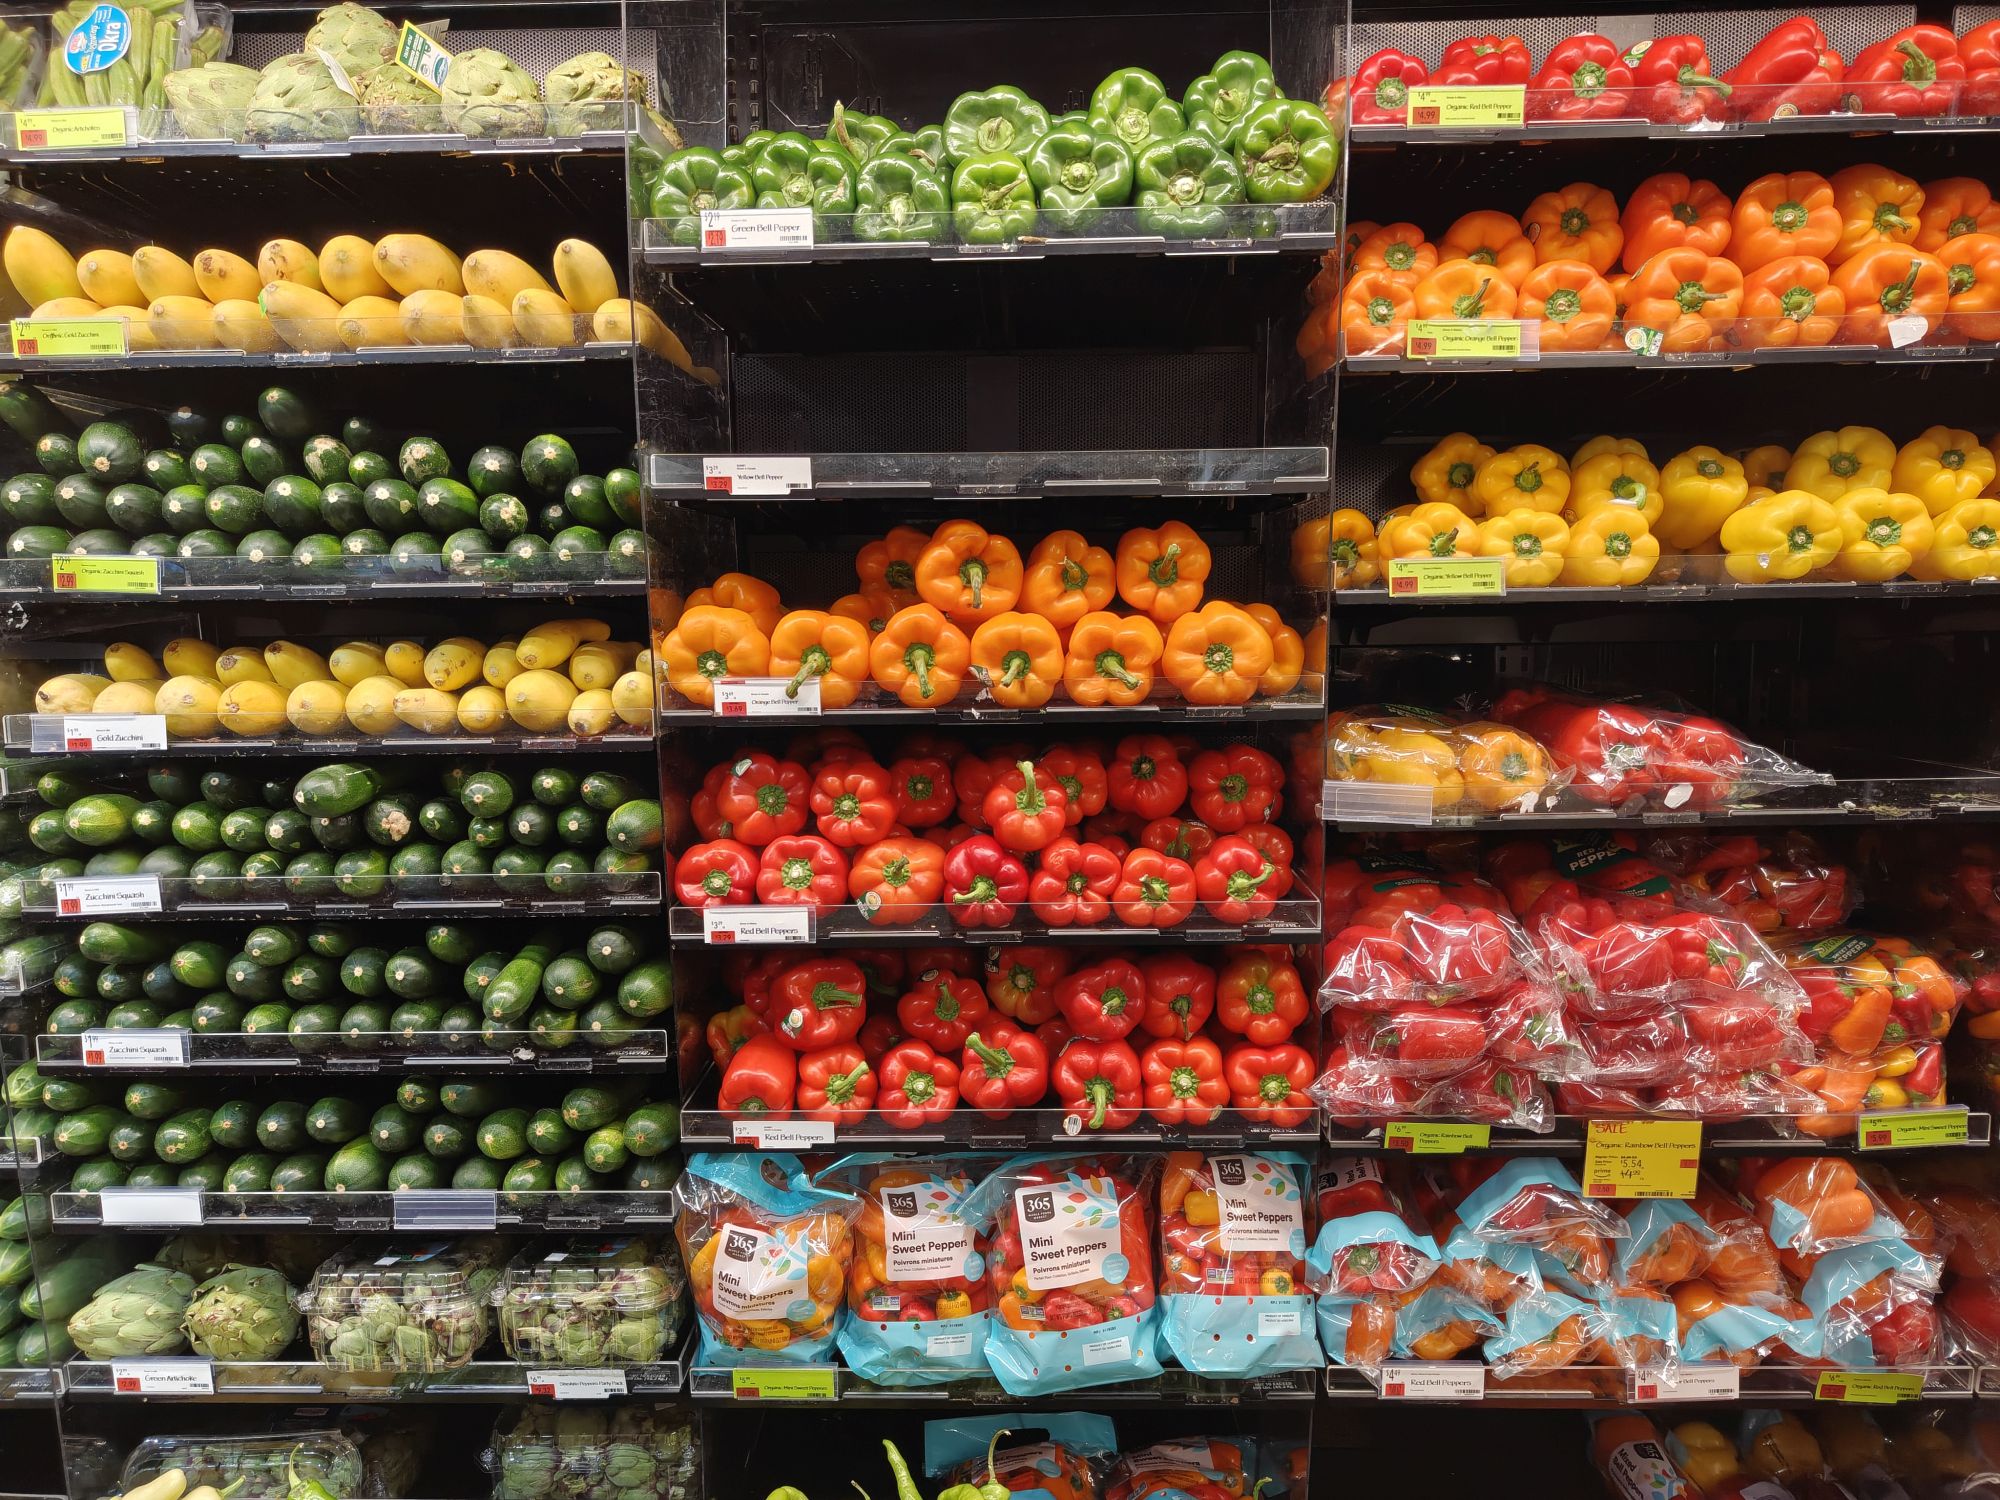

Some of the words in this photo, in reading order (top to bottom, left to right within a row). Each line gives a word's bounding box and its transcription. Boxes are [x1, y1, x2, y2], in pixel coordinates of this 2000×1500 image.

[731, 224, 756, 232] Green
[756, 224, 772, 232] Bell
[773, 224, 800, 232] Pepper
[96, 734, 114, 742] Gold
[114, 734, 144, 742] Zucchini
[116, 892, 144, 900] Squash
[140, 1046, 167, 1054] Squash
[1595, 1124, 1627, 1134] SALE
[765, 1133, 779, 1141] Red
[780, 1133, 794, 1141] Bell
[1595, 1142, 1621, 1150] Organic
[1221, 1162, 1242, 1176] 365
[891, 1197, 914, 1208] 365
[1027, 1197, 1051, 1213] 365
[1225, 1199, 1247, 1209] Mini
[1226, 1212, 1257, 1222] Sweet
[1258, 1212, 1293, 1223] Peppers
[892, 1231, 916, 1242] Mini
[1029, 1236, 1054, 1248] Mini
[729, 1235, 754, 1255] 365
[892, 1244, 926, 1255] Sweet
[928, 1238, 968, 1253] Peppers
[1031, 1249, 1065, 1261] Sweet
[1066, 1241, 1107, 1256] Peppers
[921, 1256, 953, 1265] miniatures
[1032, 1265, 1060, 1274] Poivrons
[1061, 1258, 1091, 1270] miniatures
[718, 1270, 741, 1286] Mini
[718, 1282, 747, 1300] Sweet
[749, 1288, 794, 1302] Peppers
[718, 1294, 741, 1309] Poivrons
[741, 1301, 775, 1310] miniatures
[1612, 1456, 1624, 1472] Bell
[1618, 1448, 1637, 1472] Mixed
